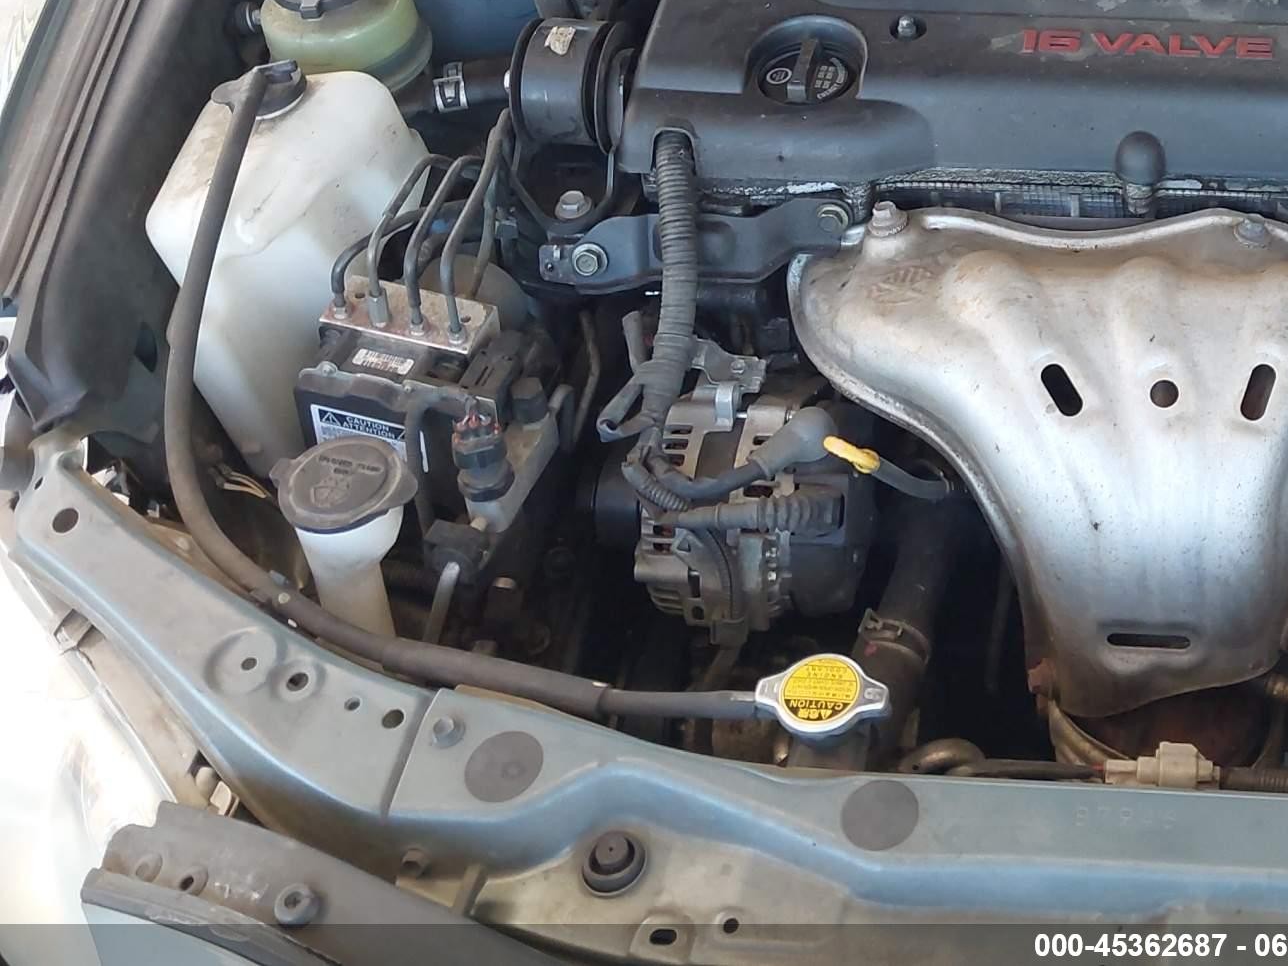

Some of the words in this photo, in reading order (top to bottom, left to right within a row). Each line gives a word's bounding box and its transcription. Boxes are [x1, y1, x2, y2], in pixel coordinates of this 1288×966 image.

[1020, 29, 1081, 54] 16
[1091, 32, 1274, 59] VALVE
[342, 421, 396, 440] ATTENTION
[345, 416, 389, 432] CAUTION
[790, 699, 843, 710] CAUTION
